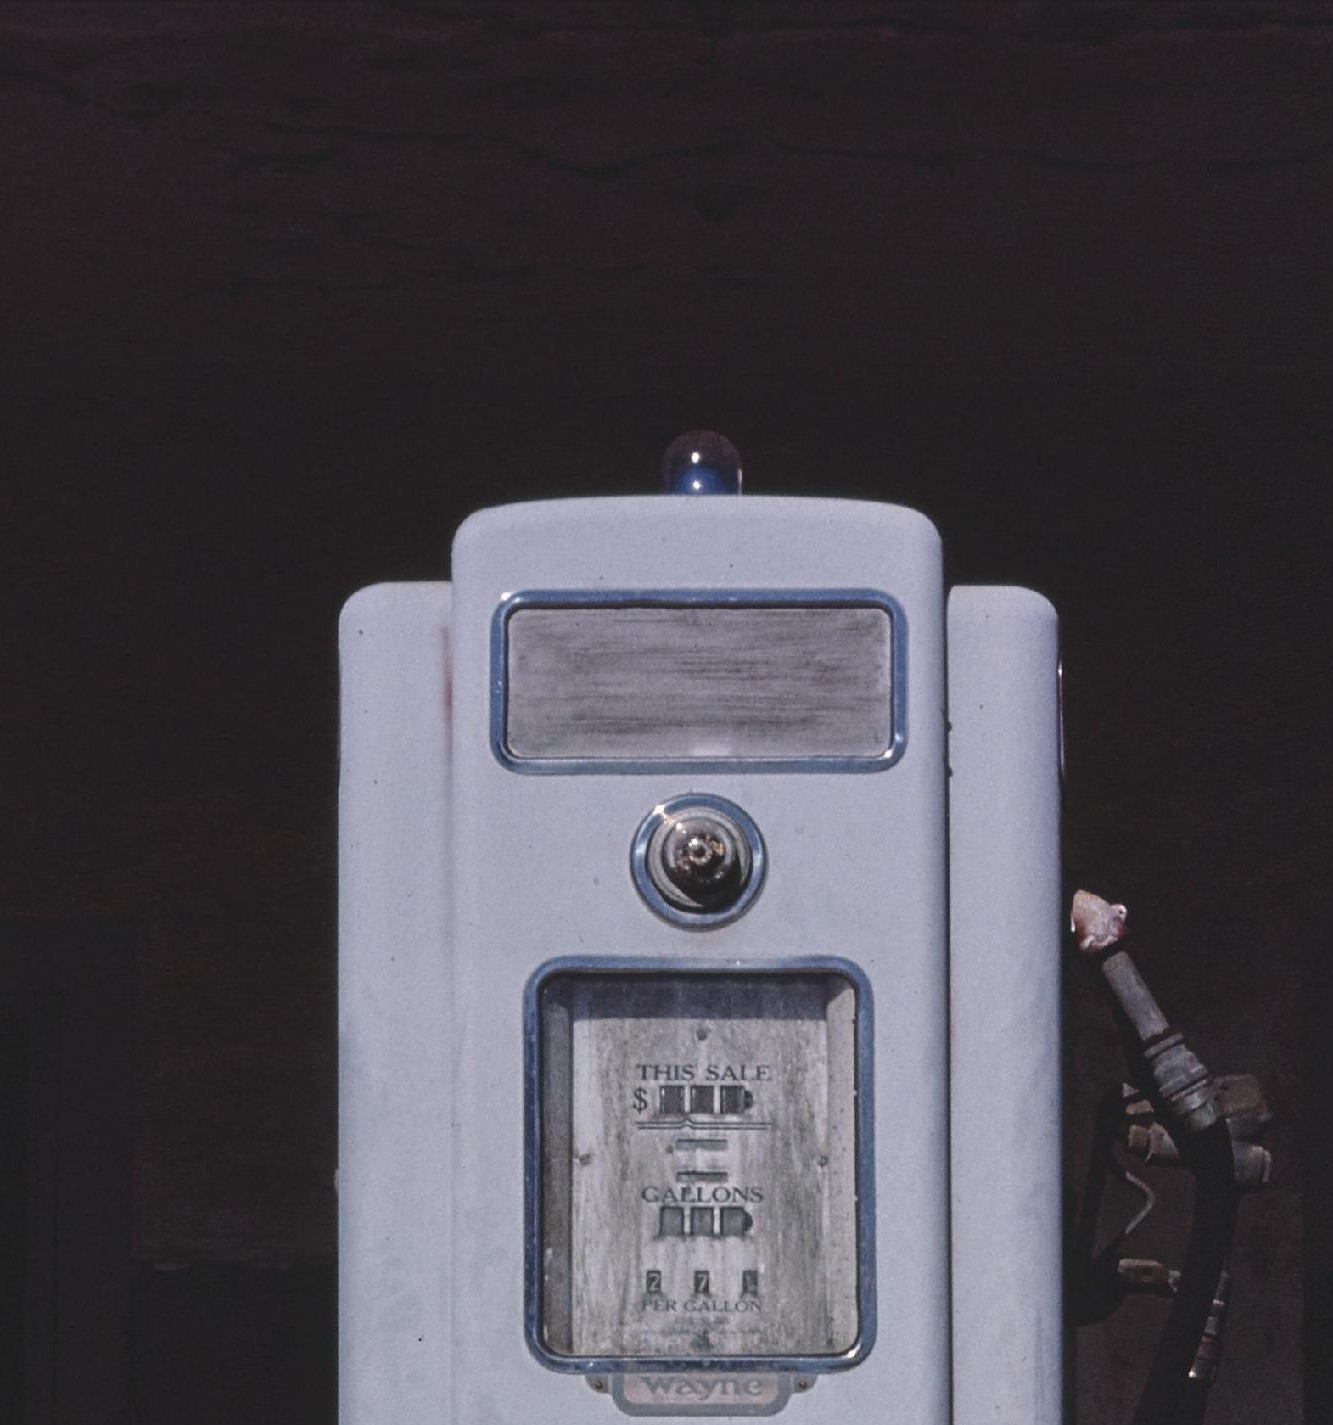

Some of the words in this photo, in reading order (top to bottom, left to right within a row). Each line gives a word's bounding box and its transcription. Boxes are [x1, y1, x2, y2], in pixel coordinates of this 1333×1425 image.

[636, 1065, 695, 1082] THIS
[706, 1065, 771, 1082] SALE
[632, 1088, 648, 1112] $
[641, 1186, 765, 1203] GALLONS
[647, 1273, 661, 1293] 2
[696, 1273, 709, 1293] 7
[642, 1300, 677, 1311] PER
[683, 1300, 762, 1312] GALLON
